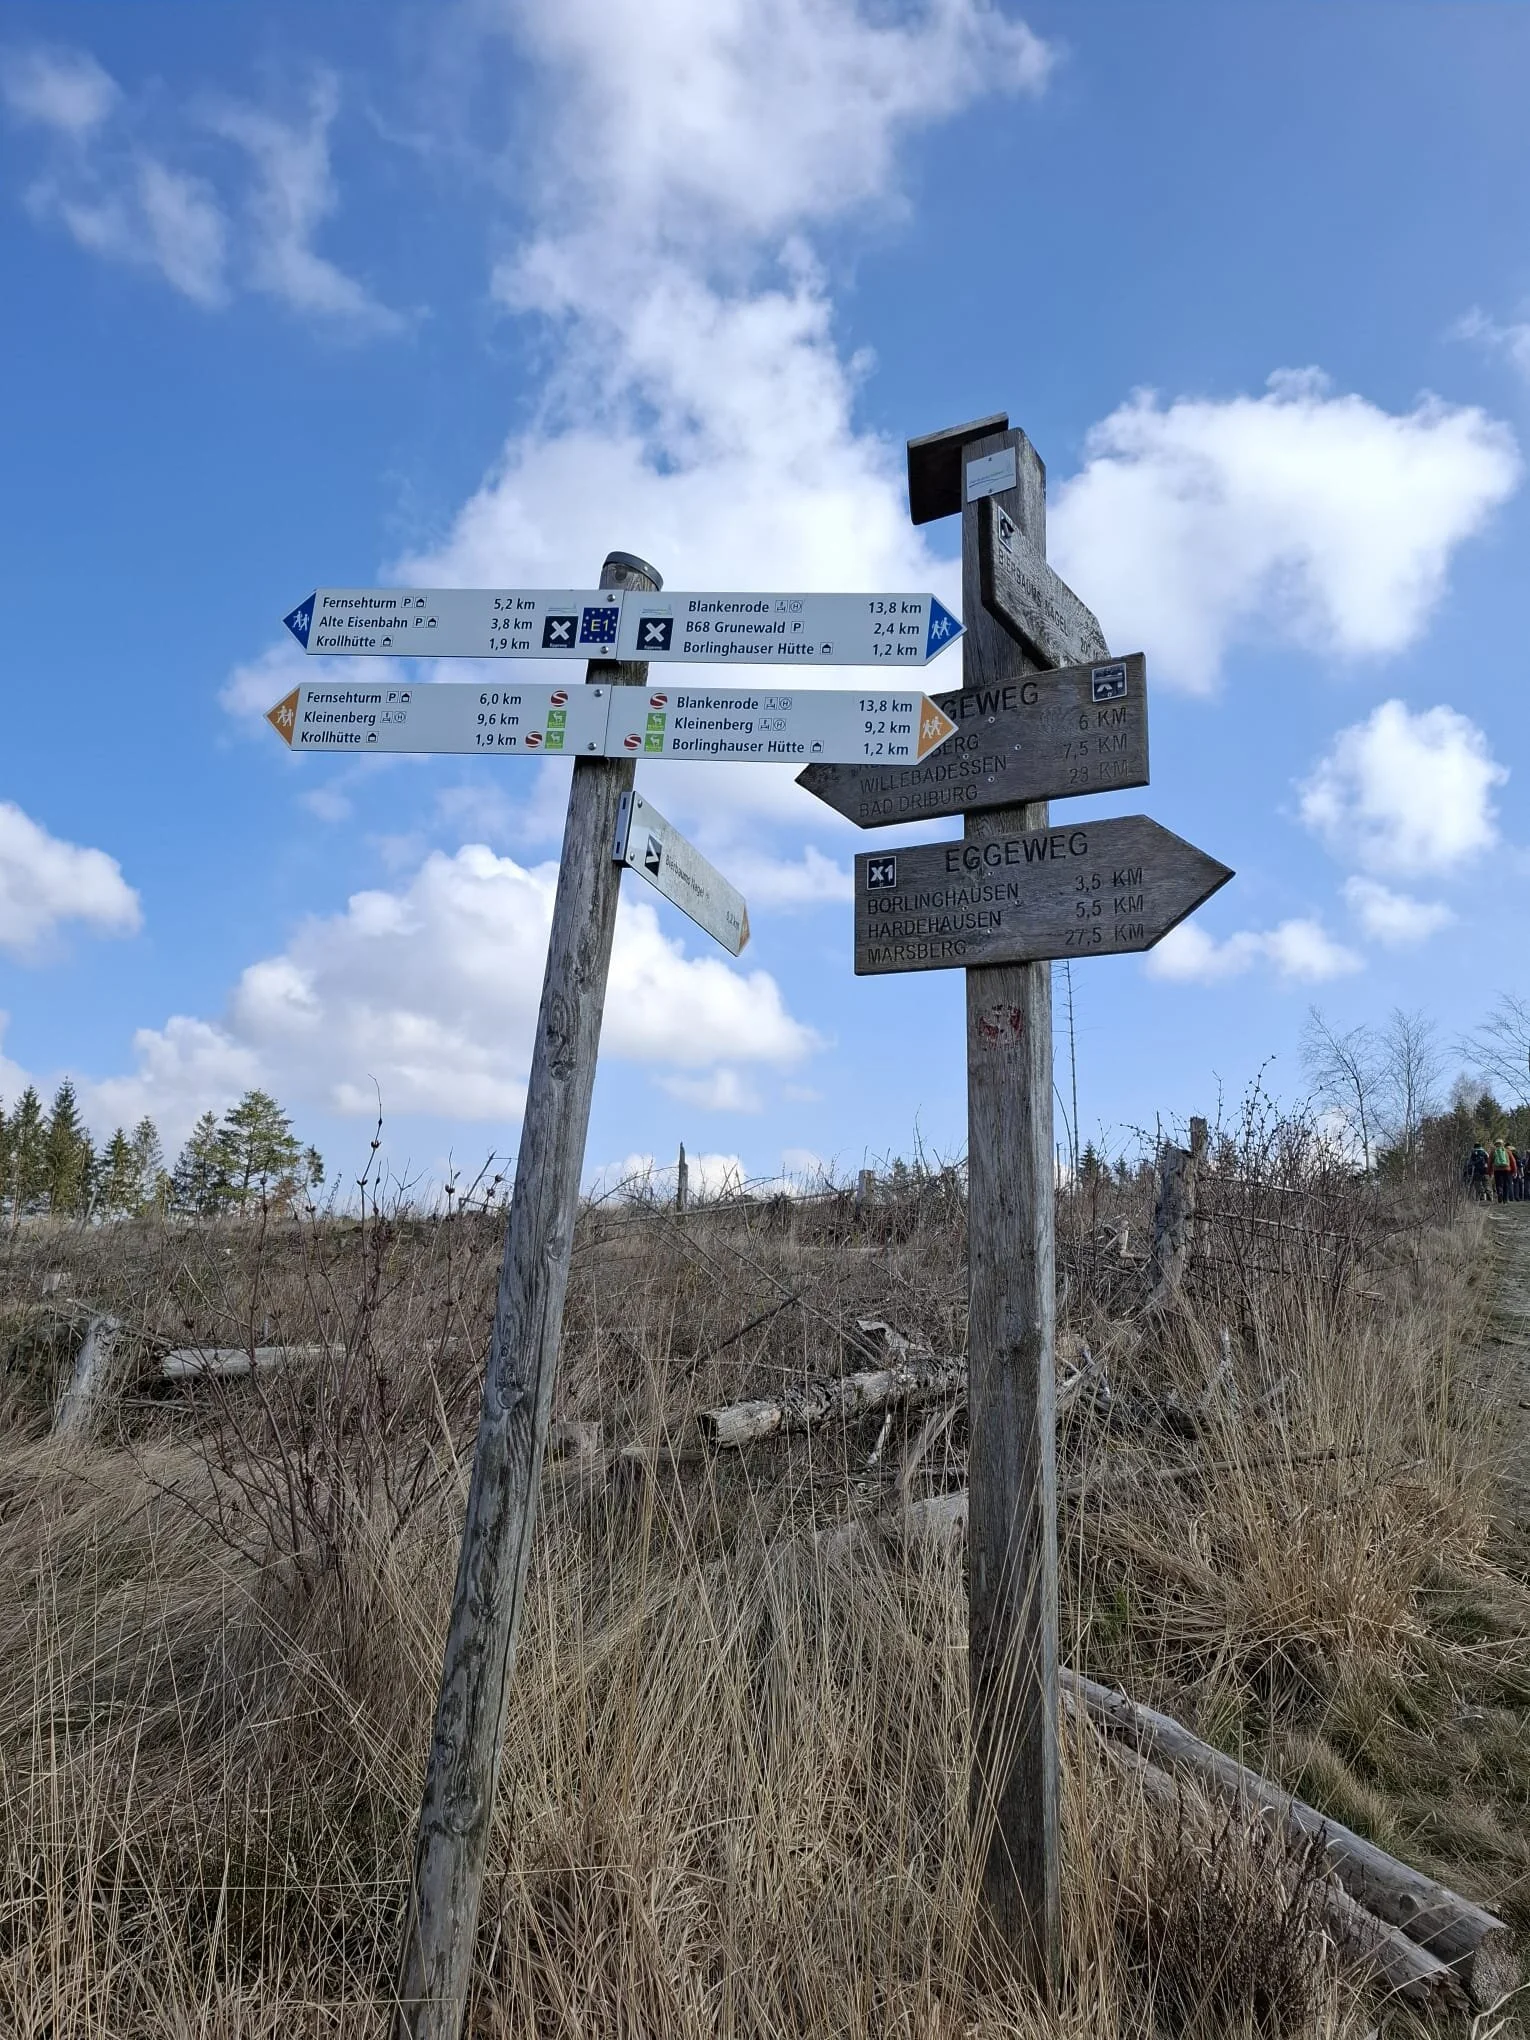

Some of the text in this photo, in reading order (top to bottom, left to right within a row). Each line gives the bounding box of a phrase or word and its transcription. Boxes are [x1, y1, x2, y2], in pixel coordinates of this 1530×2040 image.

[322, 596, 397, 608] Fernsehturm
[494, 598, 535, 611] 5,2 km
[688, 600, 770, 612] Blankenrode
[868, 601, 922, 615] 13,8 km
[319, 616, 344, 628] Alte
[347, 616, 408, 628] Eisenbahn
[490, 618, 532, 630] 3,8 km
[590, 618, 610, 632] E1
[686, 621, 710, 632] B68
[714, 621, 786, 634] Grunewald
[874, 622, 920, 636] 2,4 km
[316, 636, 376, 647] Krollhütte
[489, 638, 530, 650] 1,9 km
[683, 641, 814, 656] Borlinghauser Hütte
[872, 643, 918, 657] 1,2 km
[307, 691, 382, 704] Fernsehturm
[479, 692, 522, 706] 6,0 km
[676, 696, 759, 710] Blankenrode
[859, 700, 912, 714] 13,8 km
[304, 711, 376, 726] Kleinenberg
[477, 713, 520, 726] 9,6 km
[674, 716, 754, 734] Kleinenberg
[1078, 708, 1126, 730] 6 KM
[864, 721, 911, 735] 9,2 km
[301, 731, 361, 744] Krollhütte
[475, 734, 517, 746] 1,9 km
[672, 738, 764, 754] Borlinghauser
[768, 740, 805, 753] Hütte
[864, 742, 909, 756] 1,2 km
[1063, 733, 1127, 760] 7,5 KM
[860, 754, 1007, 794] WILLEBADESSEN
[1098, 760, 1128, 780] KM
[860, 784, 978, 818] BAD DRIBURG
[946, 832, 1088, 872] EGGEWEG
[870, 864, 894, 883] X1
[1075, 867, 1142, 892] 3,5 KM
[868, 882, 1018, 914] BORLINGHAUSEN
[1076, 894, 1143, 919] 5,5 KM
[868, 910, 1002, 938] HARDEHAUSEN
[1065, 924, 1144, 946] 27,5 KM
[868, 940, 966, 963] MARSBERG
